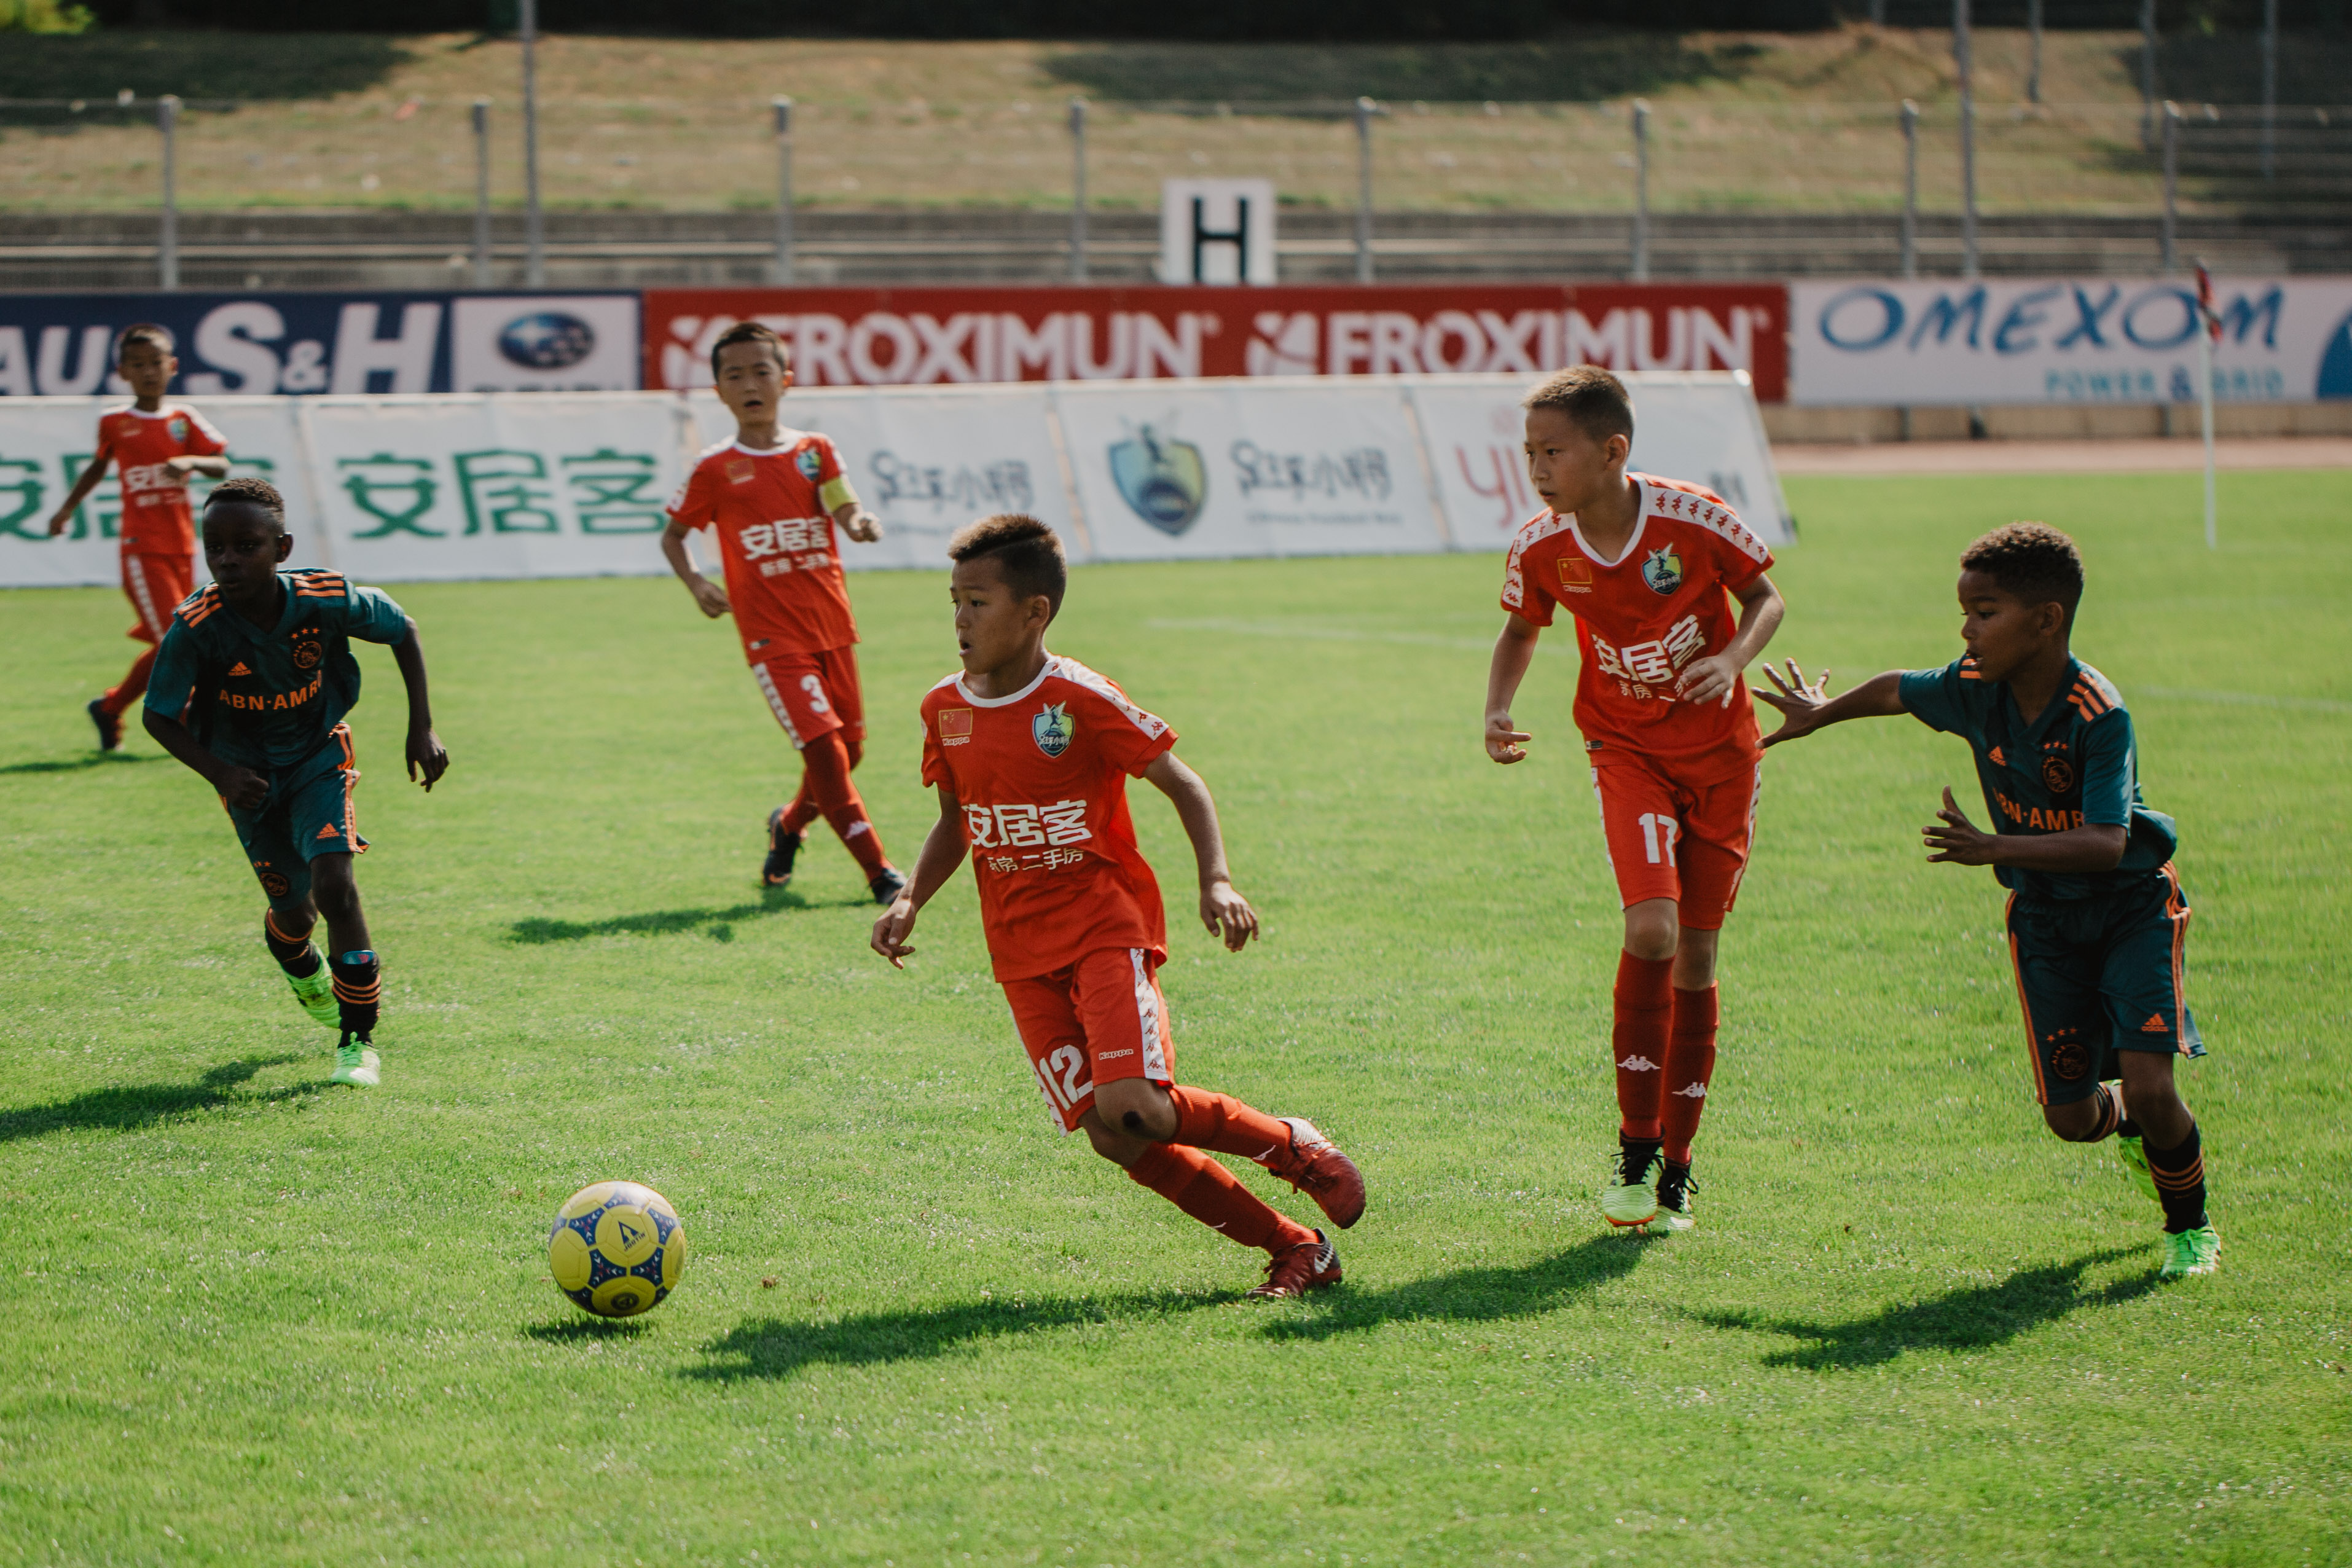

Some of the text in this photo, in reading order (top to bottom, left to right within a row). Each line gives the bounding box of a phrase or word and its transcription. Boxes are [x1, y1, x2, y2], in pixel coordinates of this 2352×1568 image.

[1191, 194, 1248, 283] H
[1817, 283, 2286, 356] OMEXOM
[335, 449, 668, 539] 安居客
[801, 675, 830, 714] 3
[1638, 812, 1679, 868] 17
[1039, 1045, 1094, 1111] 12
[1099, 1048, 1134, 1060] Kappa
